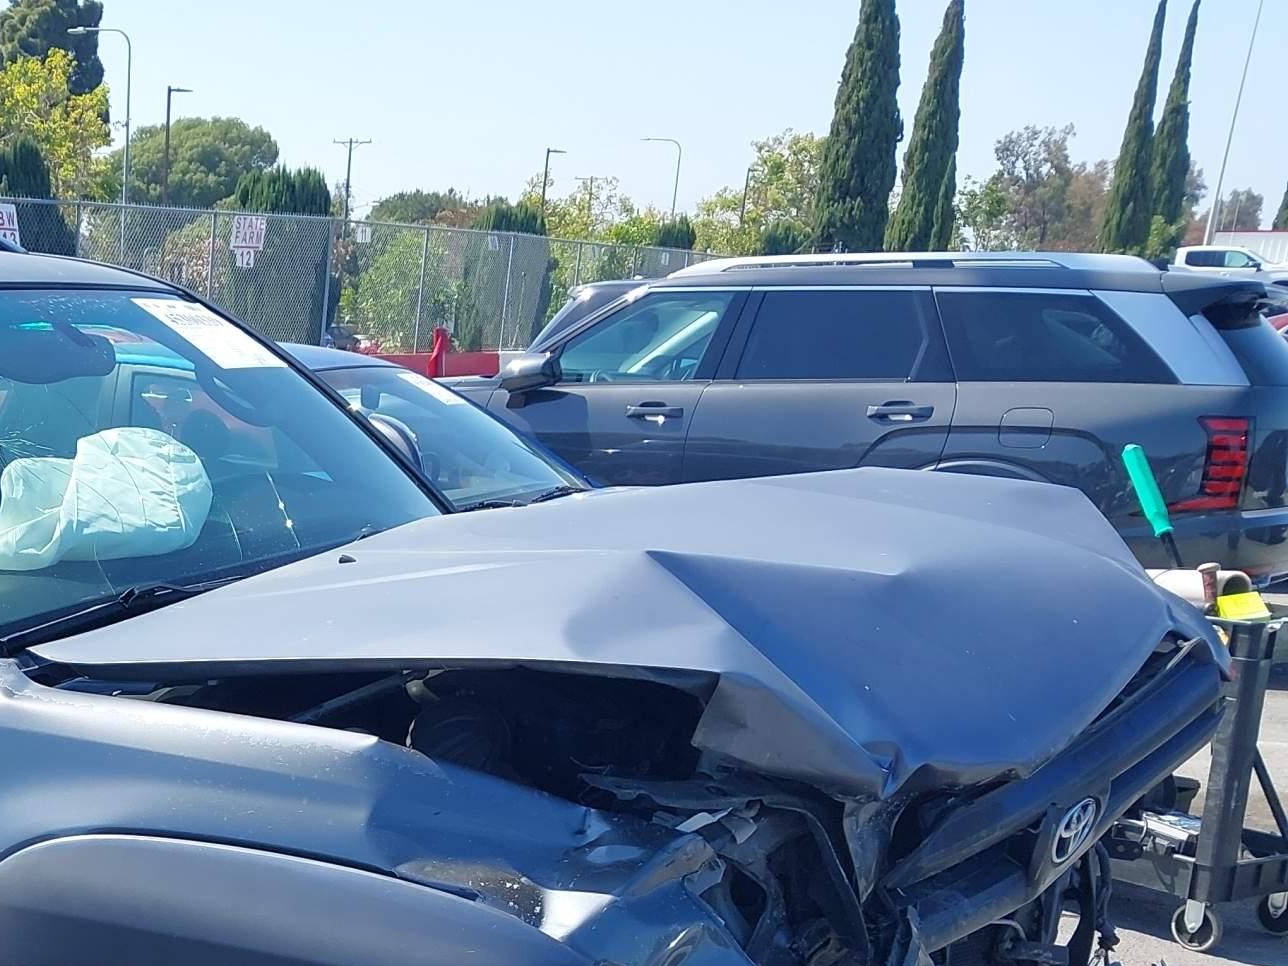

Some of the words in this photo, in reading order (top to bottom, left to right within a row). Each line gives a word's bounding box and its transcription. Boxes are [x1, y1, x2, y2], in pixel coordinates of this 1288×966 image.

[236, 217, 265, 230] STATE
[234, 231, 262, 244] FARM
[240, 250, 252, 267] 12
